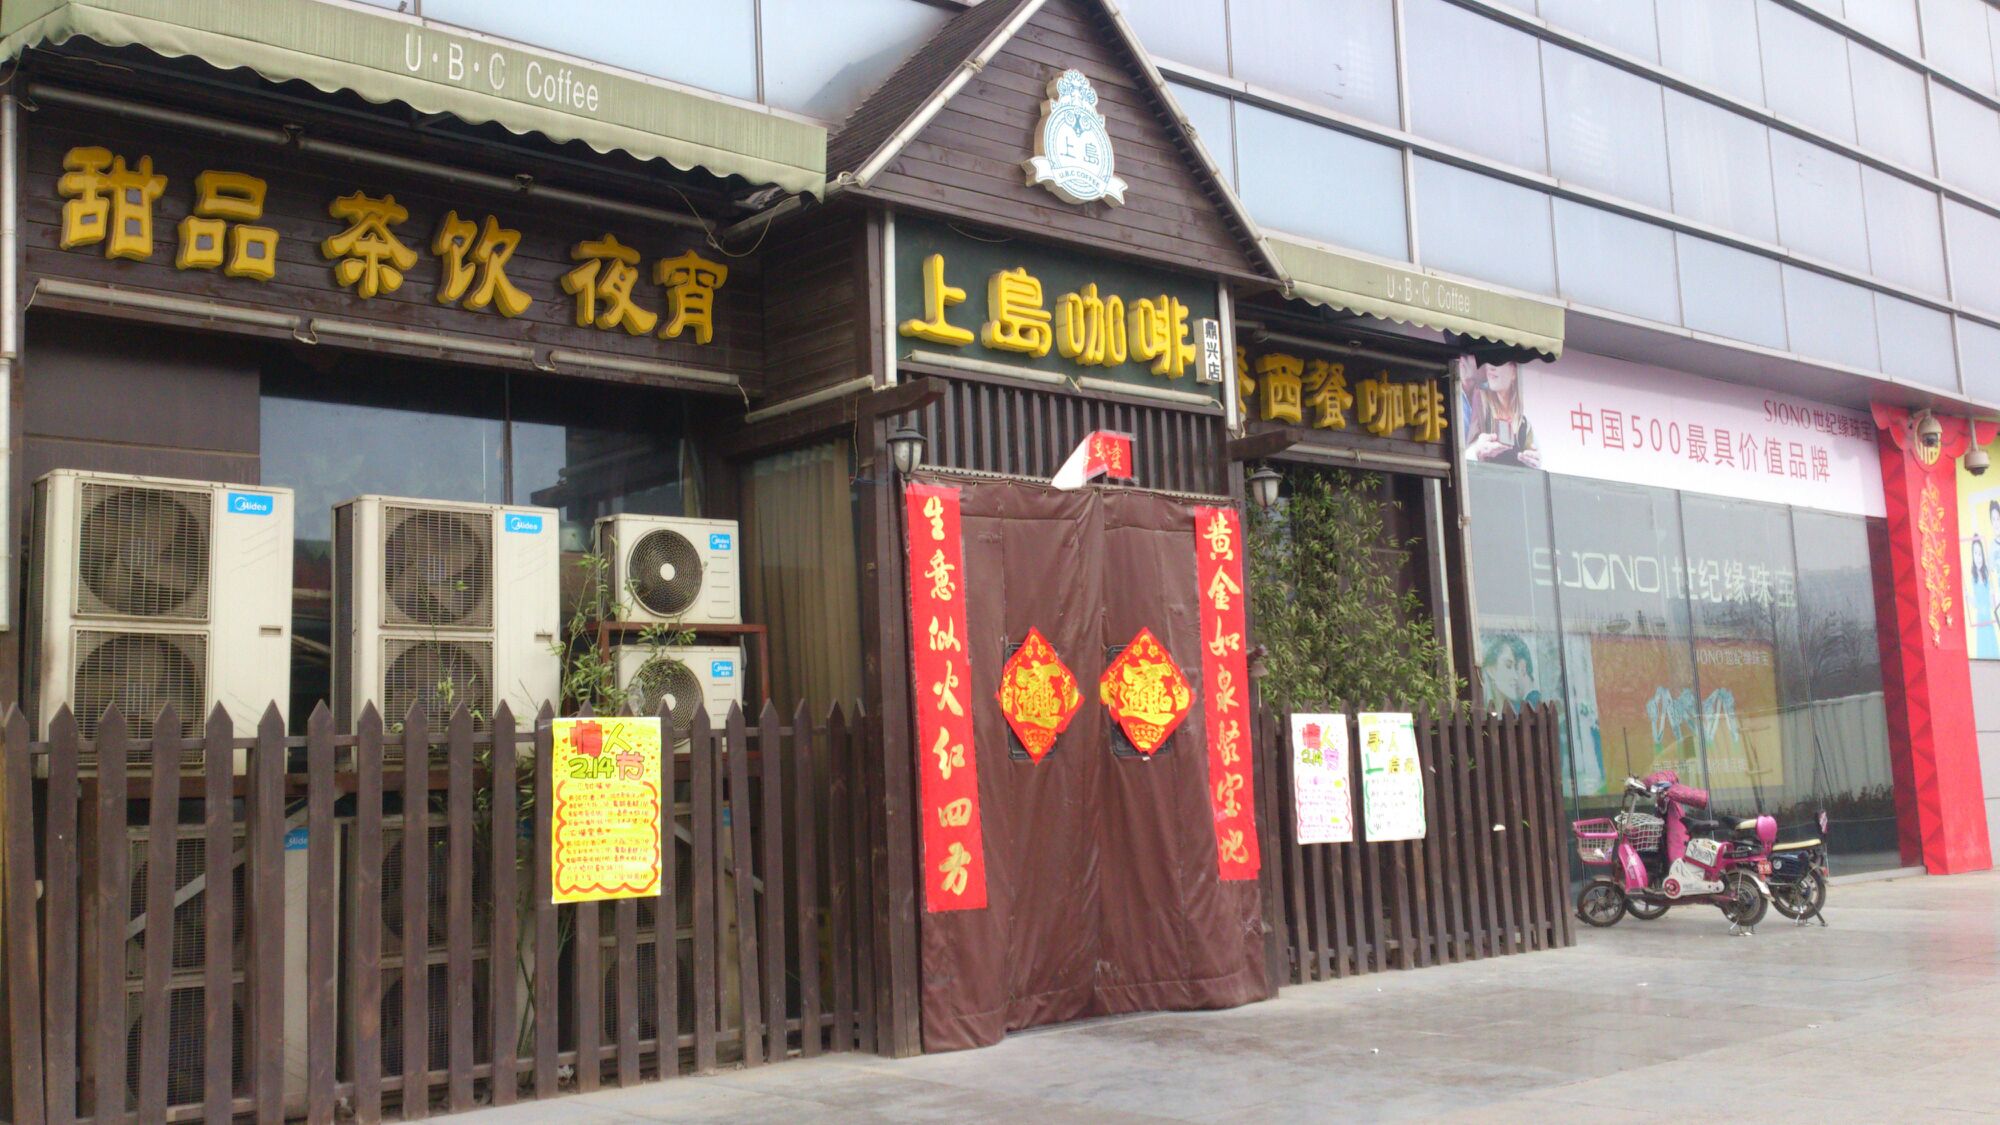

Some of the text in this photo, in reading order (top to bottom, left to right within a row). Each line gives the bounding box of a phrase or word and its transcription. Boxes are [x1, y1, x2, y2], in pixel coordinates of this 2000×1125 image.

[526, 61, 599, 111] Coffee
[57, 145, 280, 281] 甜品
[900, 253, 1196, 380] 上島咖啡
[1437, 284, 1470, 313] Coffee
[1205, 320, 1220, 380] 鼎兴店
[1570, 402, 1831, 483] 中国500最具价值品牌
[238, 499, 267, 511] Midea
[514, 519, 538, 530] Midea
[923, 496, 973, 896] 生意似火红四方
